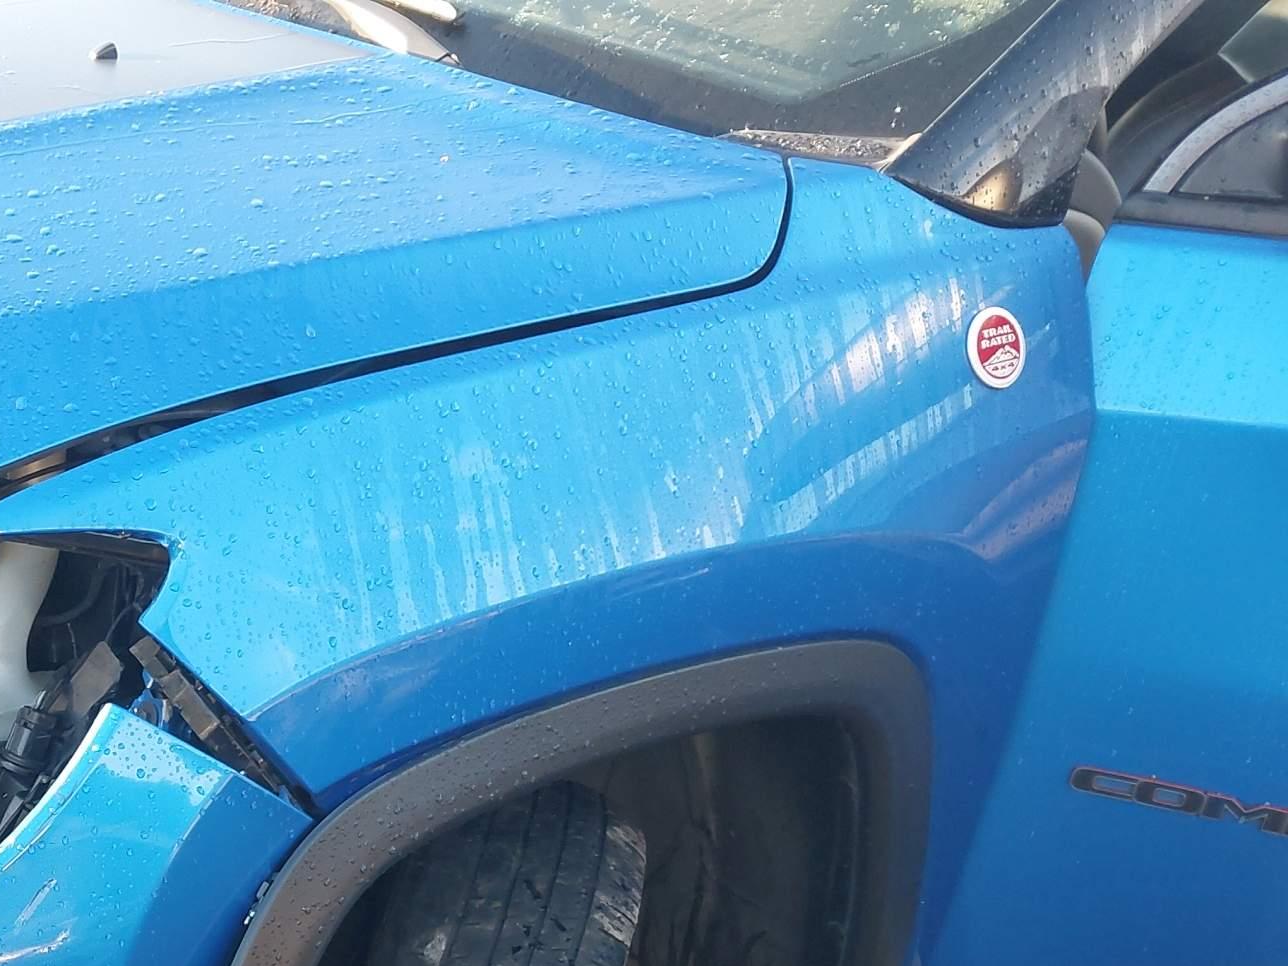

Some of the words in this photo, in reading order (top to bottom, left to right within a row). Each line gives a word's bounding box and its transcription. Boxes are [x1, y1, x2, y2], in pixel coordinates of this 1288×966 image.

[981, 324, 1015, 339] TRAIL
[980, 333, 1017, 350] RATED
[1070, 766, 1288, 838] COM
